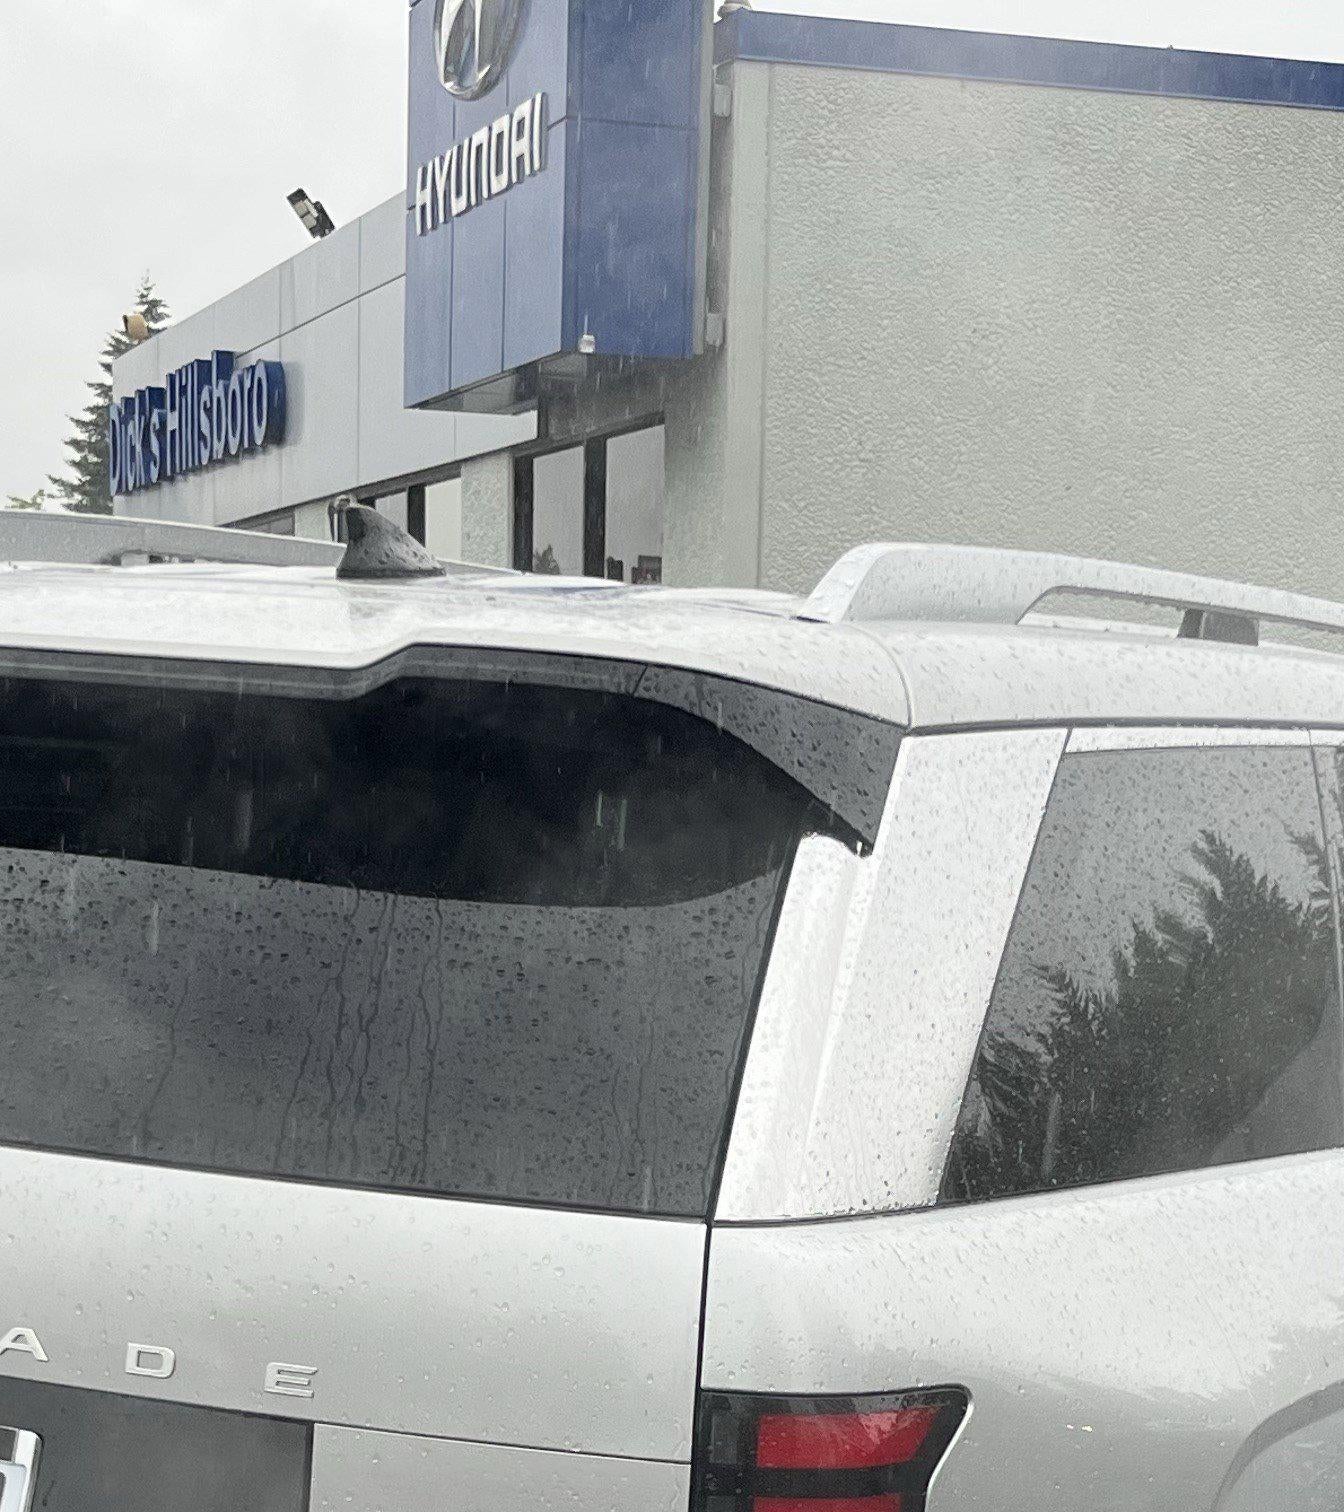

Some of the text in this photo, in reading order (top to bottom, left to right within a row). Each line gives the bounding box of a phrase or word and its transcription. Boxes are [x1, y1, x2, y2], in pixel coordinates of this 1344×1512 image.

[415, 91, 543, 237] HYUNDAI
[109, 350, 269, 497] Dick's Hillsboro
